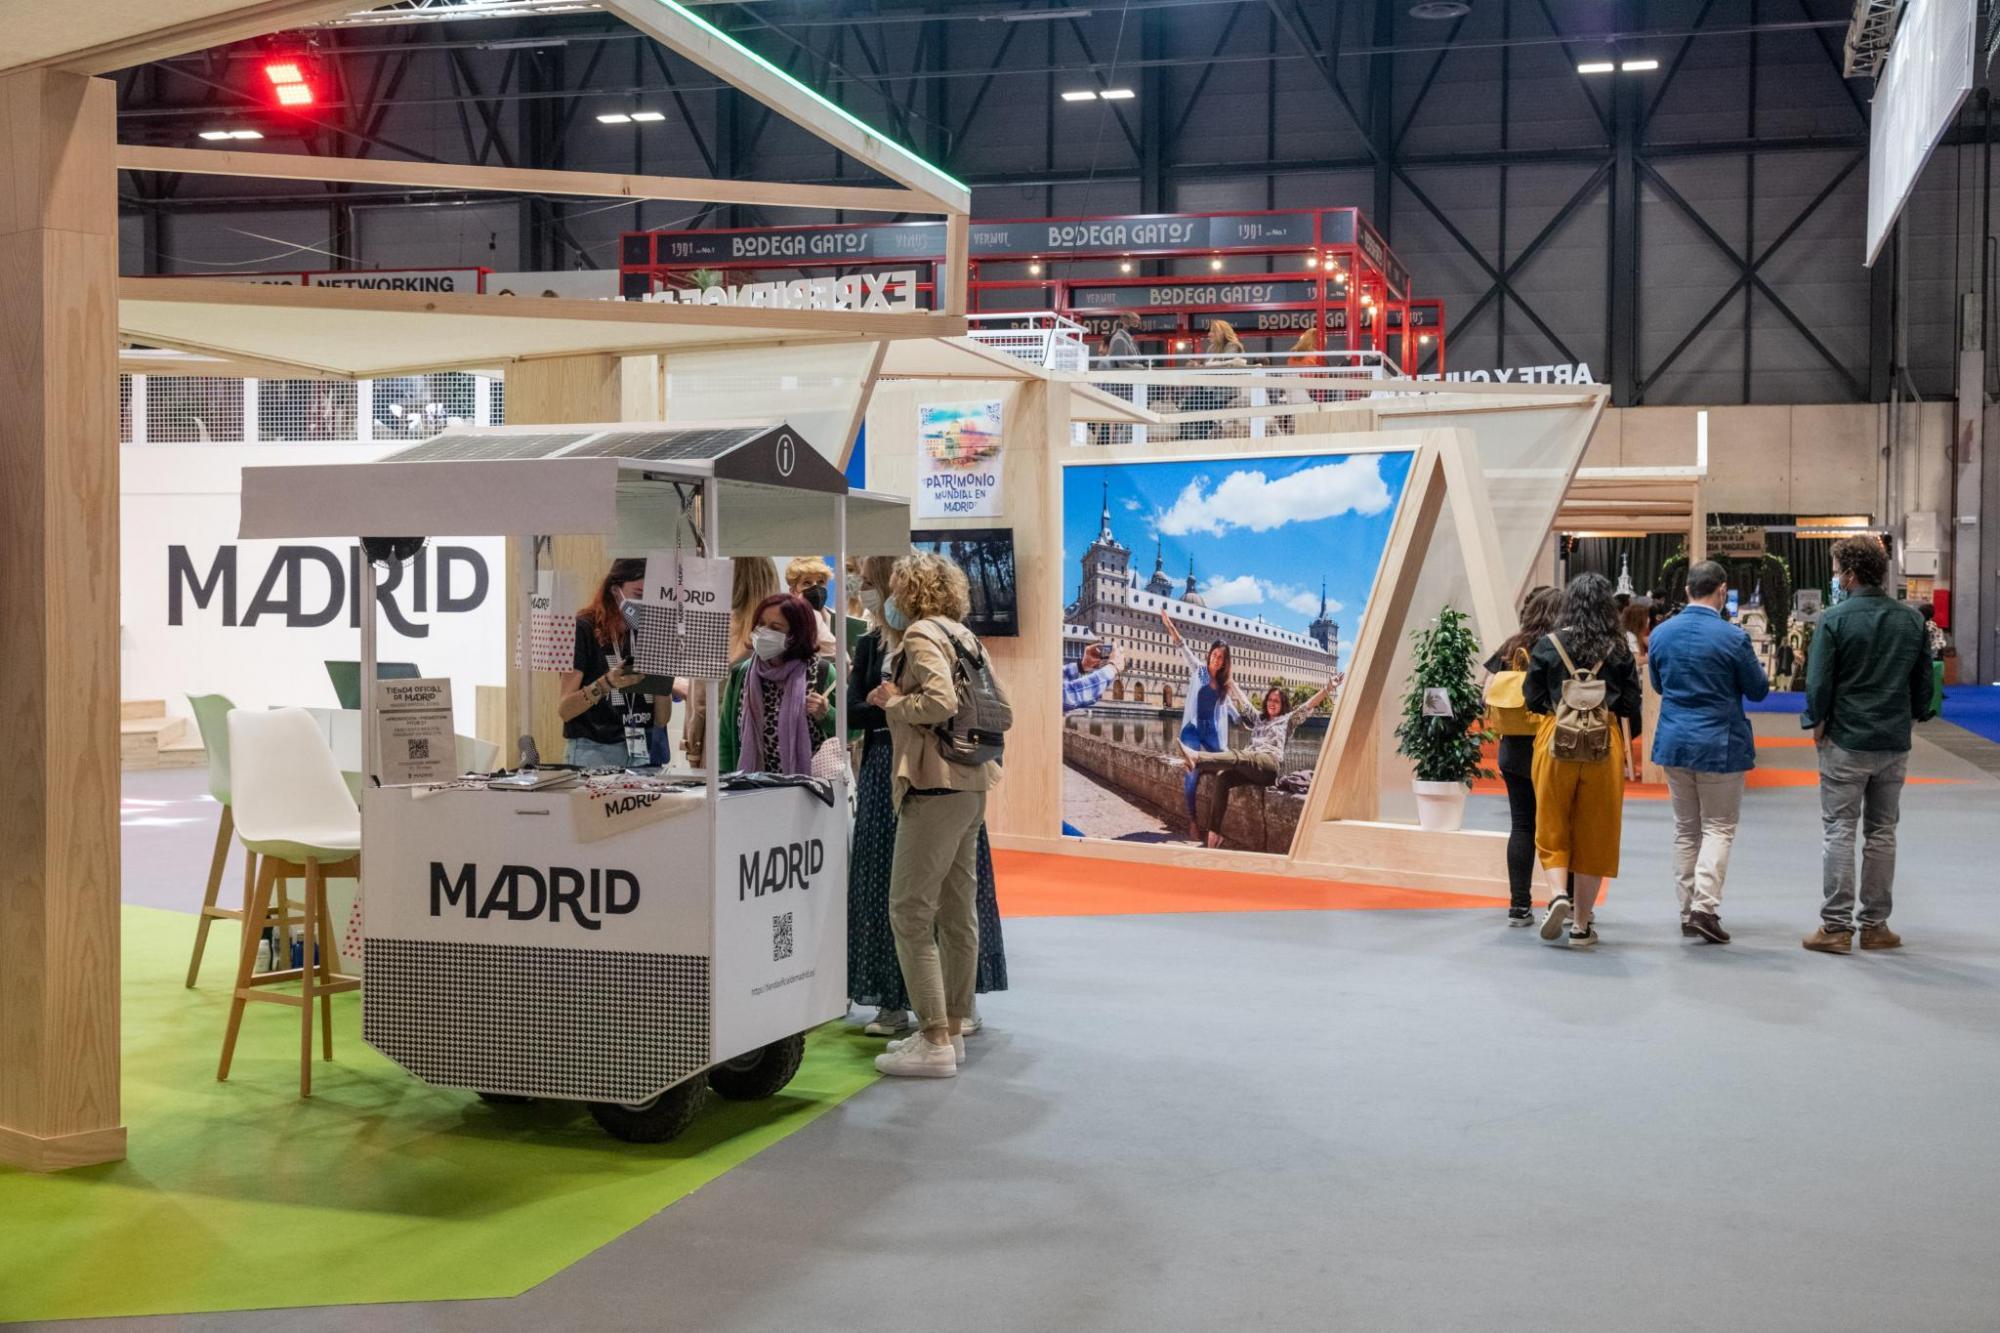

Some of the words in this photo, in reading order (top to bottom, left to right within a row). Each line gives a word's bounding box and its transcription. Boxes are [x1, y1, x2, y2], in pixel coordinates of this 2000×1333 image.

[732, 235, 806, 257] BODEGA
[811, 233, 868, 255] GATOS
[1048, 224, 1127, 247] BODEGA
[1131, 223, 1195, 245] GATOS
[318, 276, 454, 292] NETWORKING
[1150, 287, 1216, 305] BODEGA
[1220, 285, 1273, 303] GATOS
[1083, 319, 1120, 335] ATOS
[1258, 313, 1317, 330] BODEGA
[1325, 310, 1371, 328] GAS
[926, 473, 995, 490] PATRIMONIO
[935, 489, 973, 500] MUNDIAL
[975, 489, 986, 498] EN
[944, 501, 975, 512] MADRID
[168, 545, 490, 638] MADRID
[660, 586, 716, 606] MDRID
[404, 693, 436, 702] MADRID
[605, 793, 661, 818] MADRID
[740, 838, 824, 901] MADRID
[430, 861, 641, 931] MADRID
